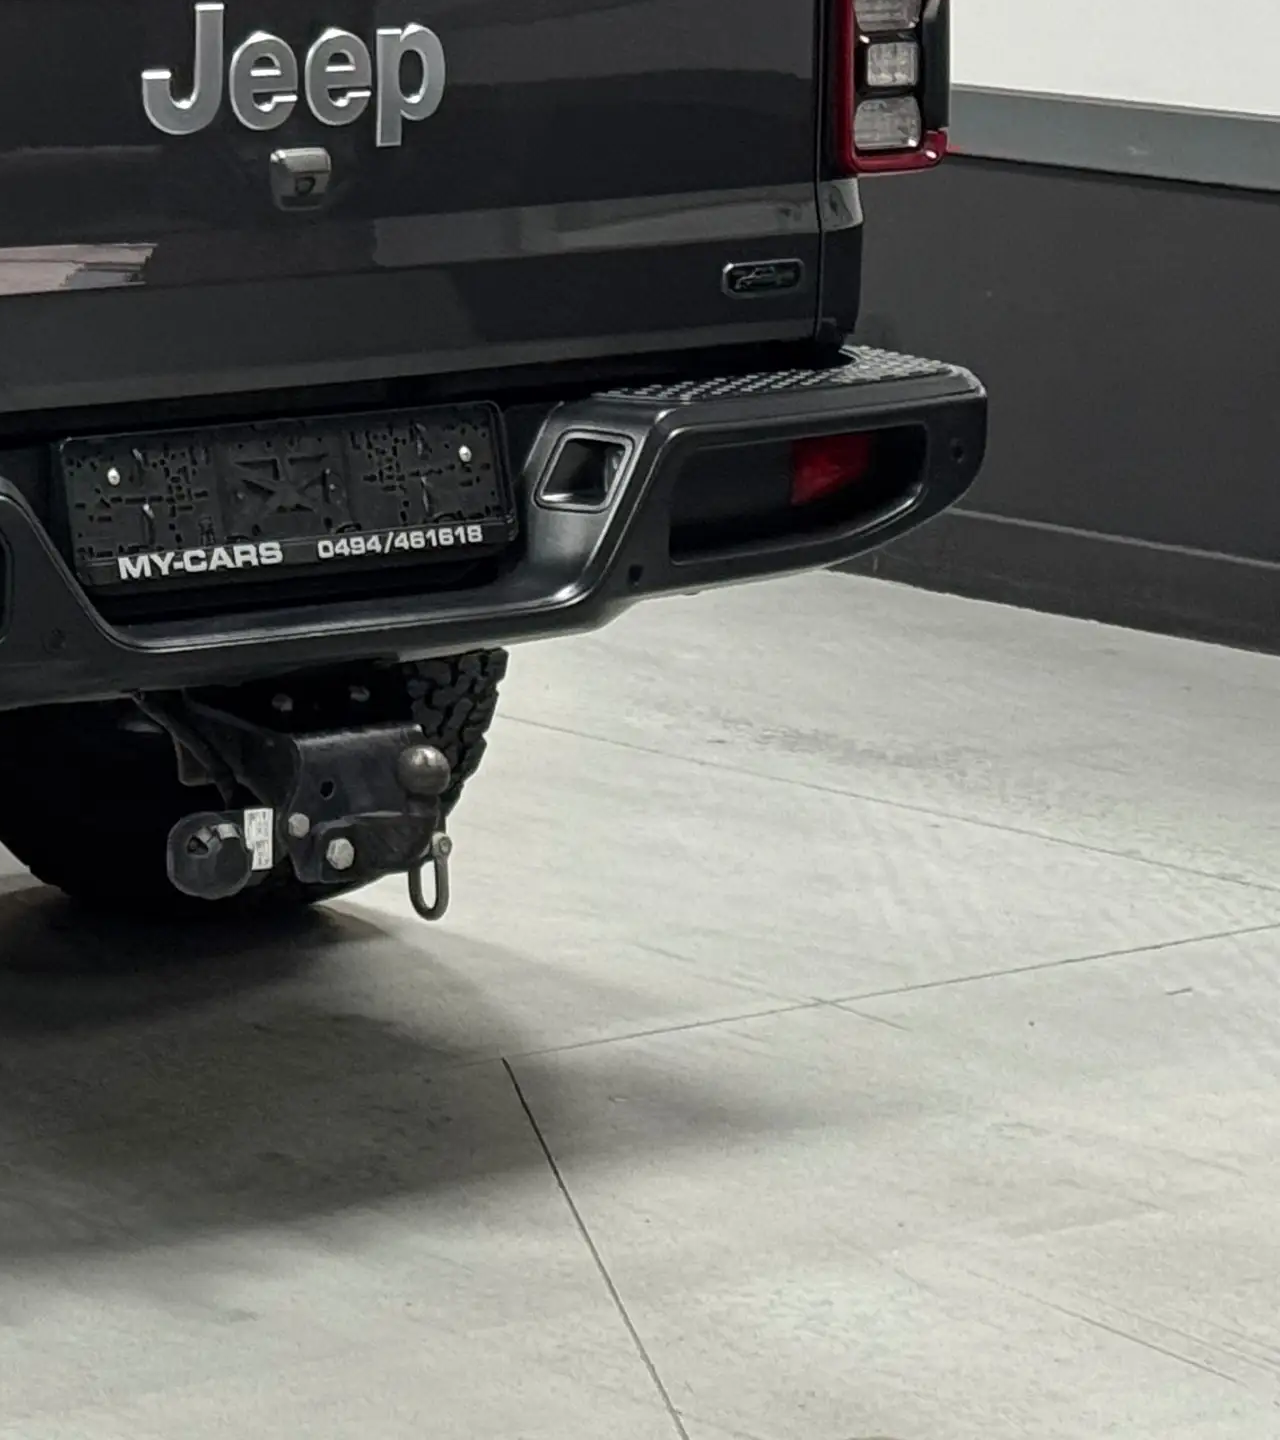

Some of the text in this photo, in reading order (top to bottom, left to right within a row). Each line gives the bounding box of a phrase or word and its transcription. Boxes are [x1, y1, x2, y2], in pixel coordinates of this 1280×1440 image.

[141, 2, 446, 147] Jeep
[117, 524, 484, 581] MY-CARS 0494/461618
